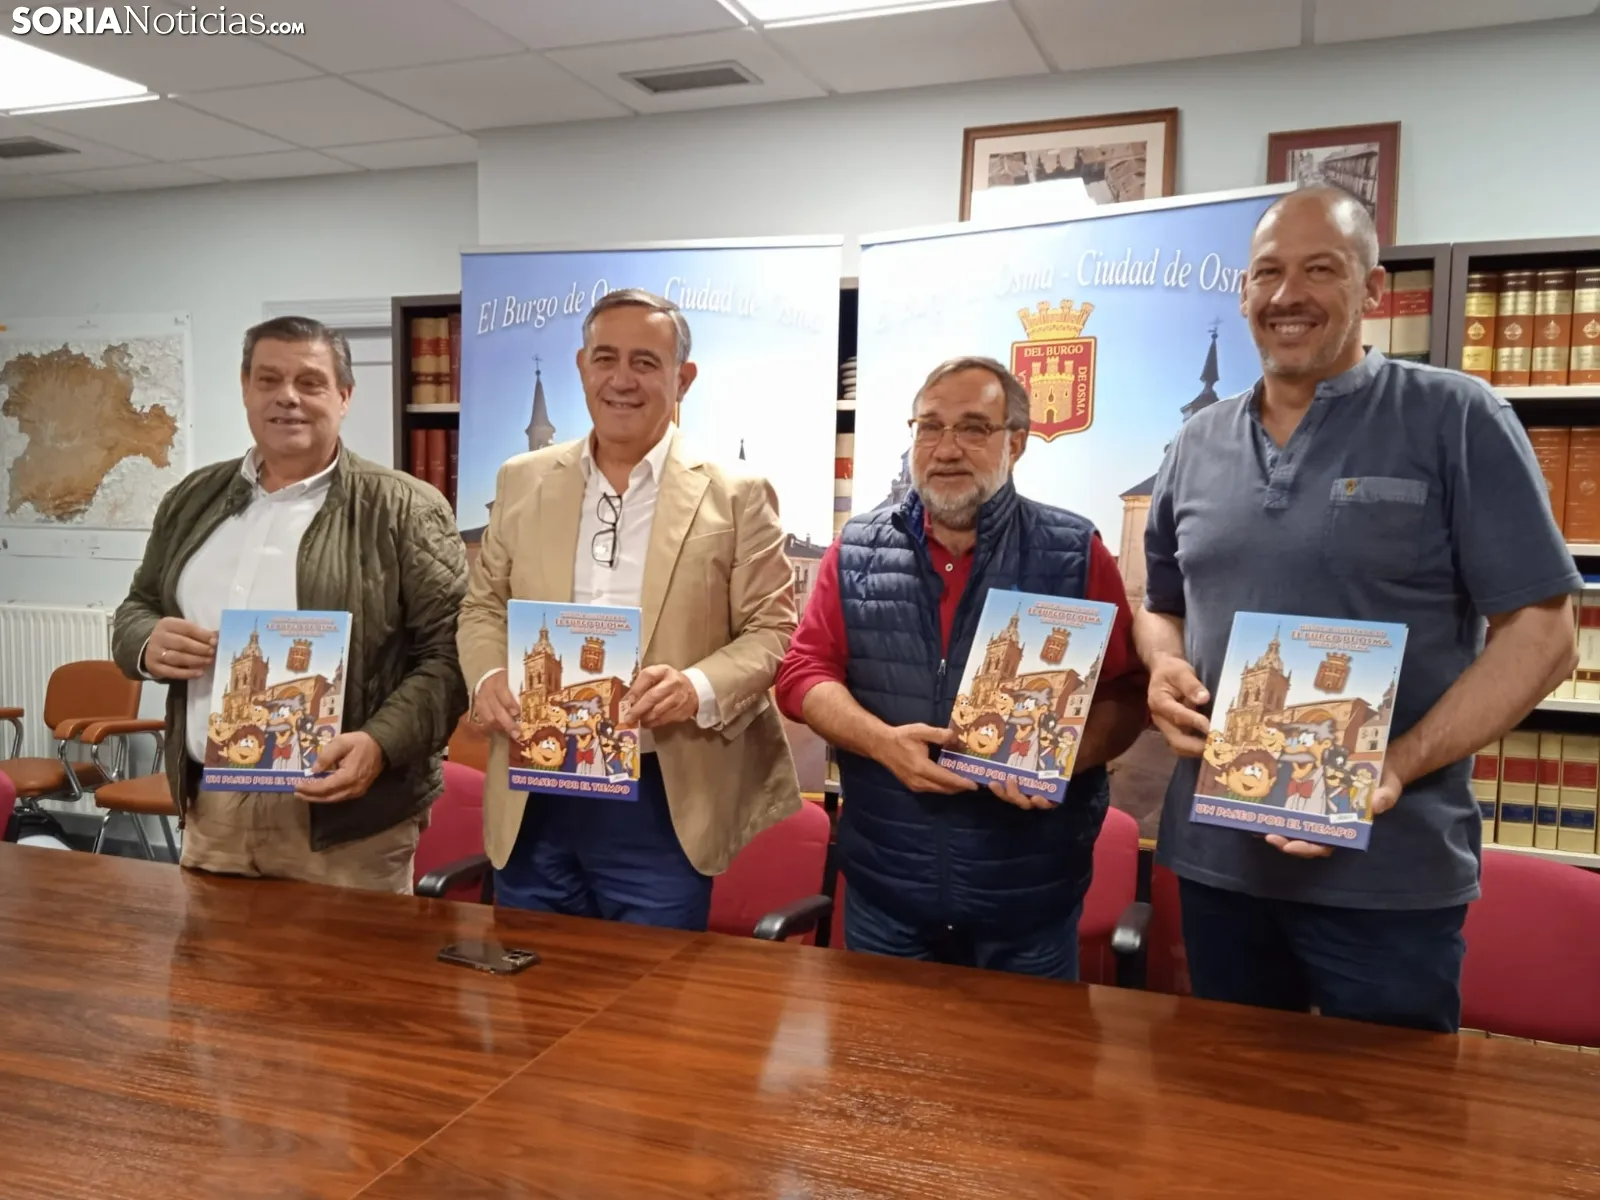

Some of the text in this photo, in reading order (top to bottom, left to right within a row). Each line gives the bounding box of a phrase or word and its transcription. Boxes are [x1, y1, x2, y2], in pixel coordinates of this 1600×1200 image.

[1076, 247, 1157, 287] Ciudad
[1163, 250, 1192, 288] de
[1200, 252, 1247, 294] Osm
[476, 299, 498, 335] El
[501, 295, 558, 329] Burgo
[562, 282, 585, 314] de
[664, 276, 733, 315] Ciudad
[1024, 344, 1084, 357] DEL BURGO
[1076, 366, 1088, 416] DE OSMA
[205, 774, 220, 785] UN
[221, 775, 252, 785] PASEO
[252, 776, 274, 785] POR
[274, 776, 286, 786] EL
[511, 774, 631, 795] UN PASEO POR EL TIEMPO
[941, 758, 956, 769] UN
[956, 761, 985, 776] PASEO
[985, 768, 1006, 781] POR
[1018, 776, 1058, 793] TIEMPO
[1195, 803, 1357, 840] UN PASEO POR EL TIEMPO
